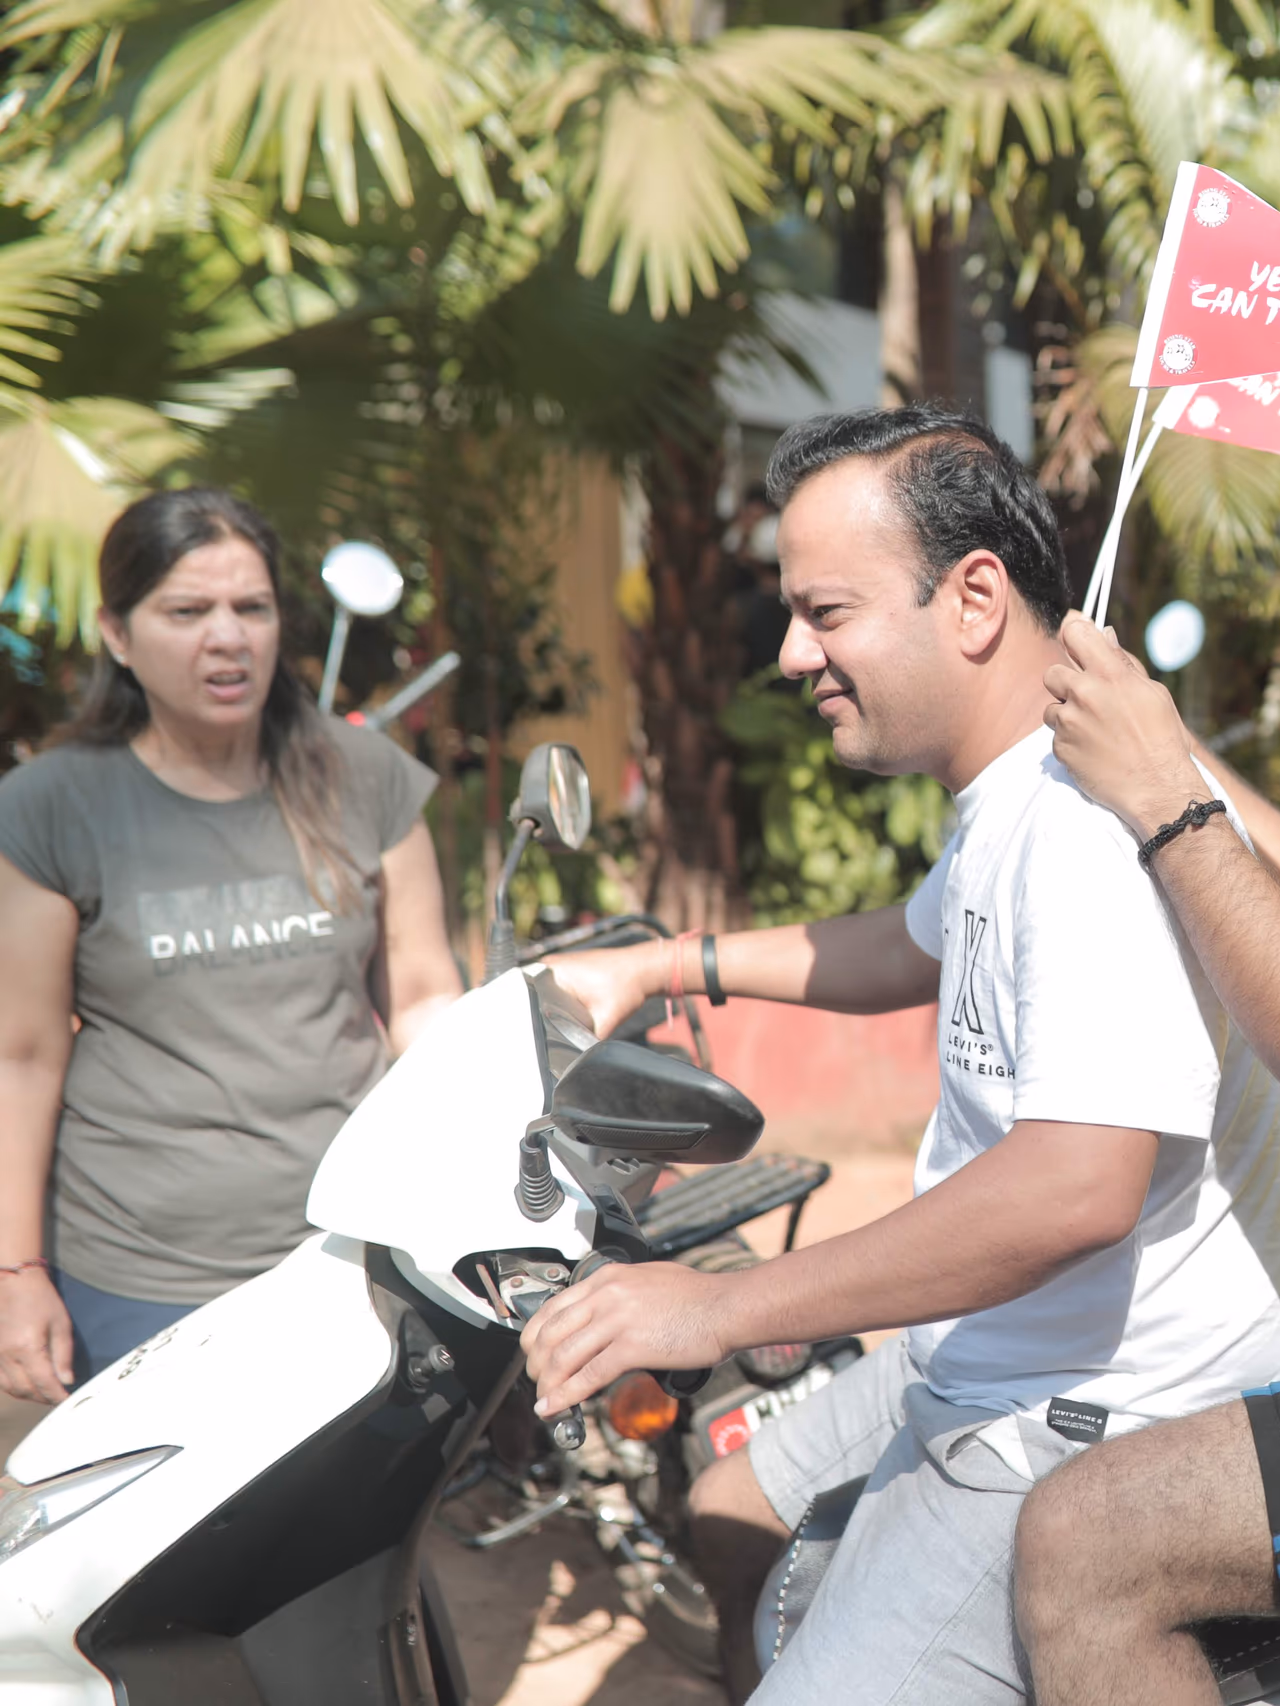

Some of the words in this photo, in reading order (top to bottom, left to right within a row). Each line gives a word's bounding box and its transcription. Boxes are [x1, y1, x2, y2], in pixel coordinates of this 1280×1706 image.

[1191, 283, 1258, 319] CAN
[1227, 375, 1280, 406] AN
[150, 910, 335, 976] BALANCE
[946, 1051, 970, 1071] LINE
[978, 1063, 1016, 1080] EIGH
